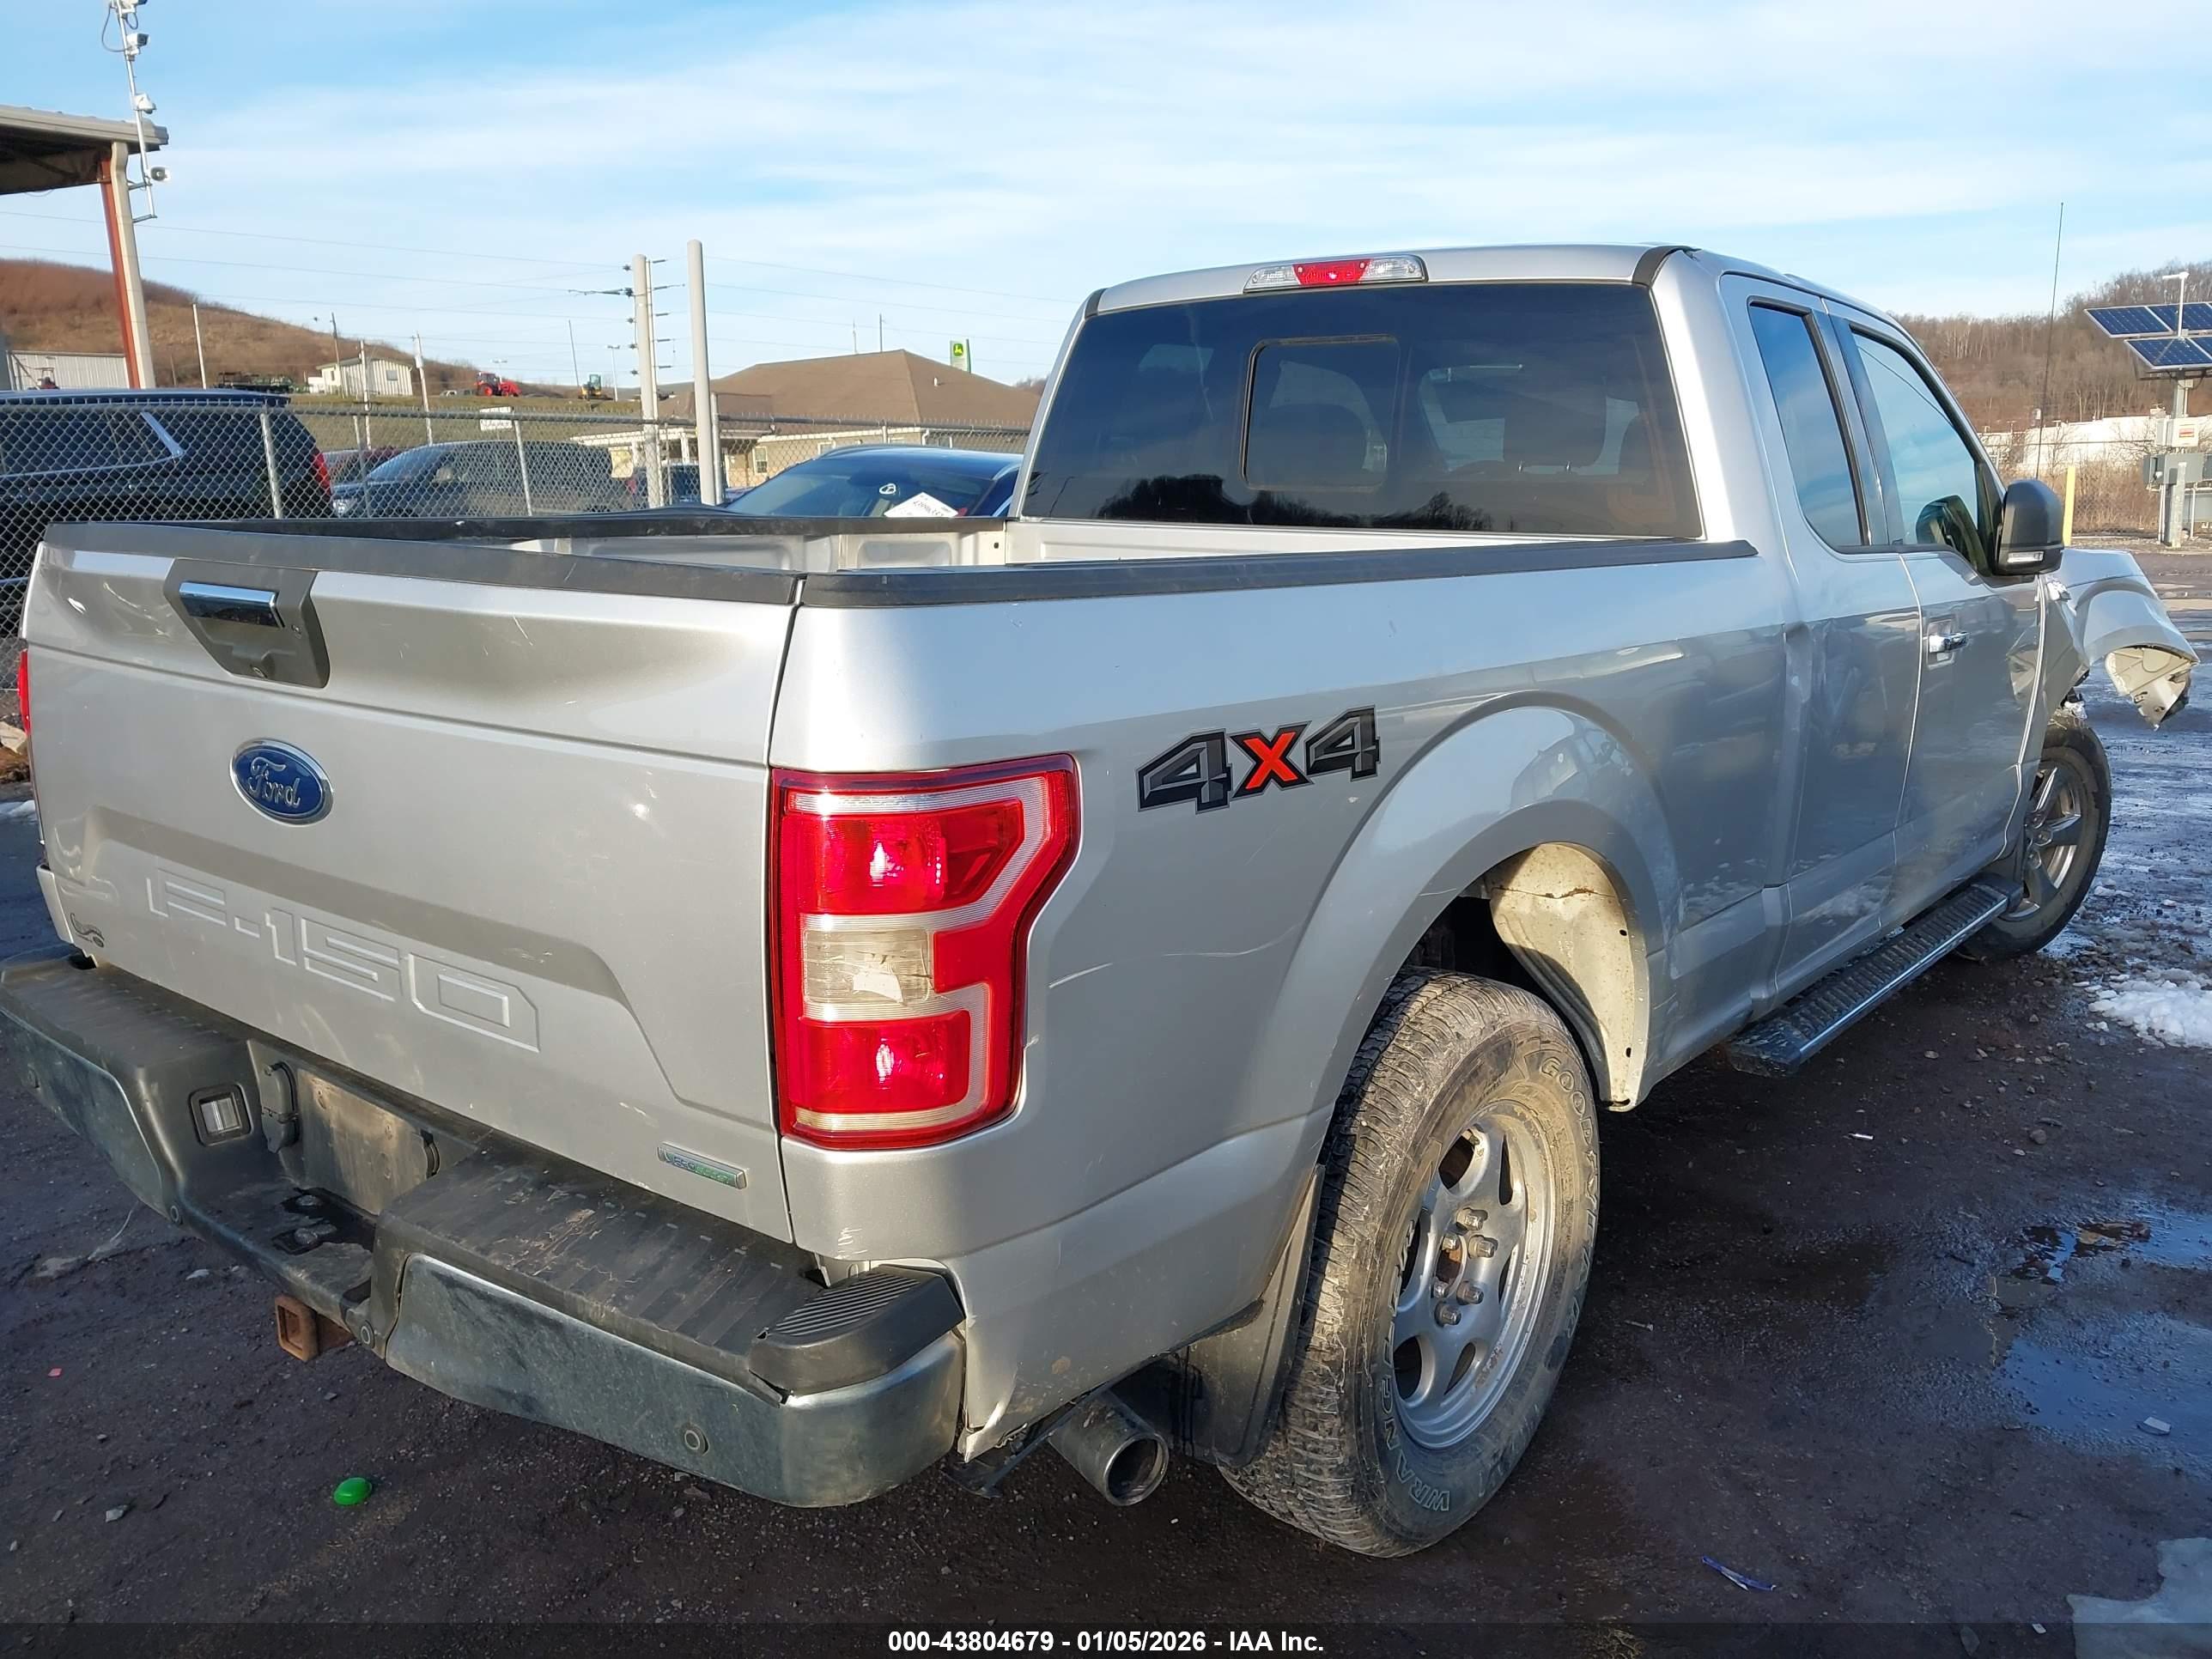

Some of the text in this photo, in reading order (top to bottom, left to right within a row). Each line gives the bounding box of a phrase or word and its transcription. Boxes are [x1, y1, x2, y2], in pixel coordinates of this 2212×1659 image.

[246, 756, 301, 808] Ford
[147, 867, 540, 1054] F-150
[1540, 1055, 1598, 1339] GOODYEAR
